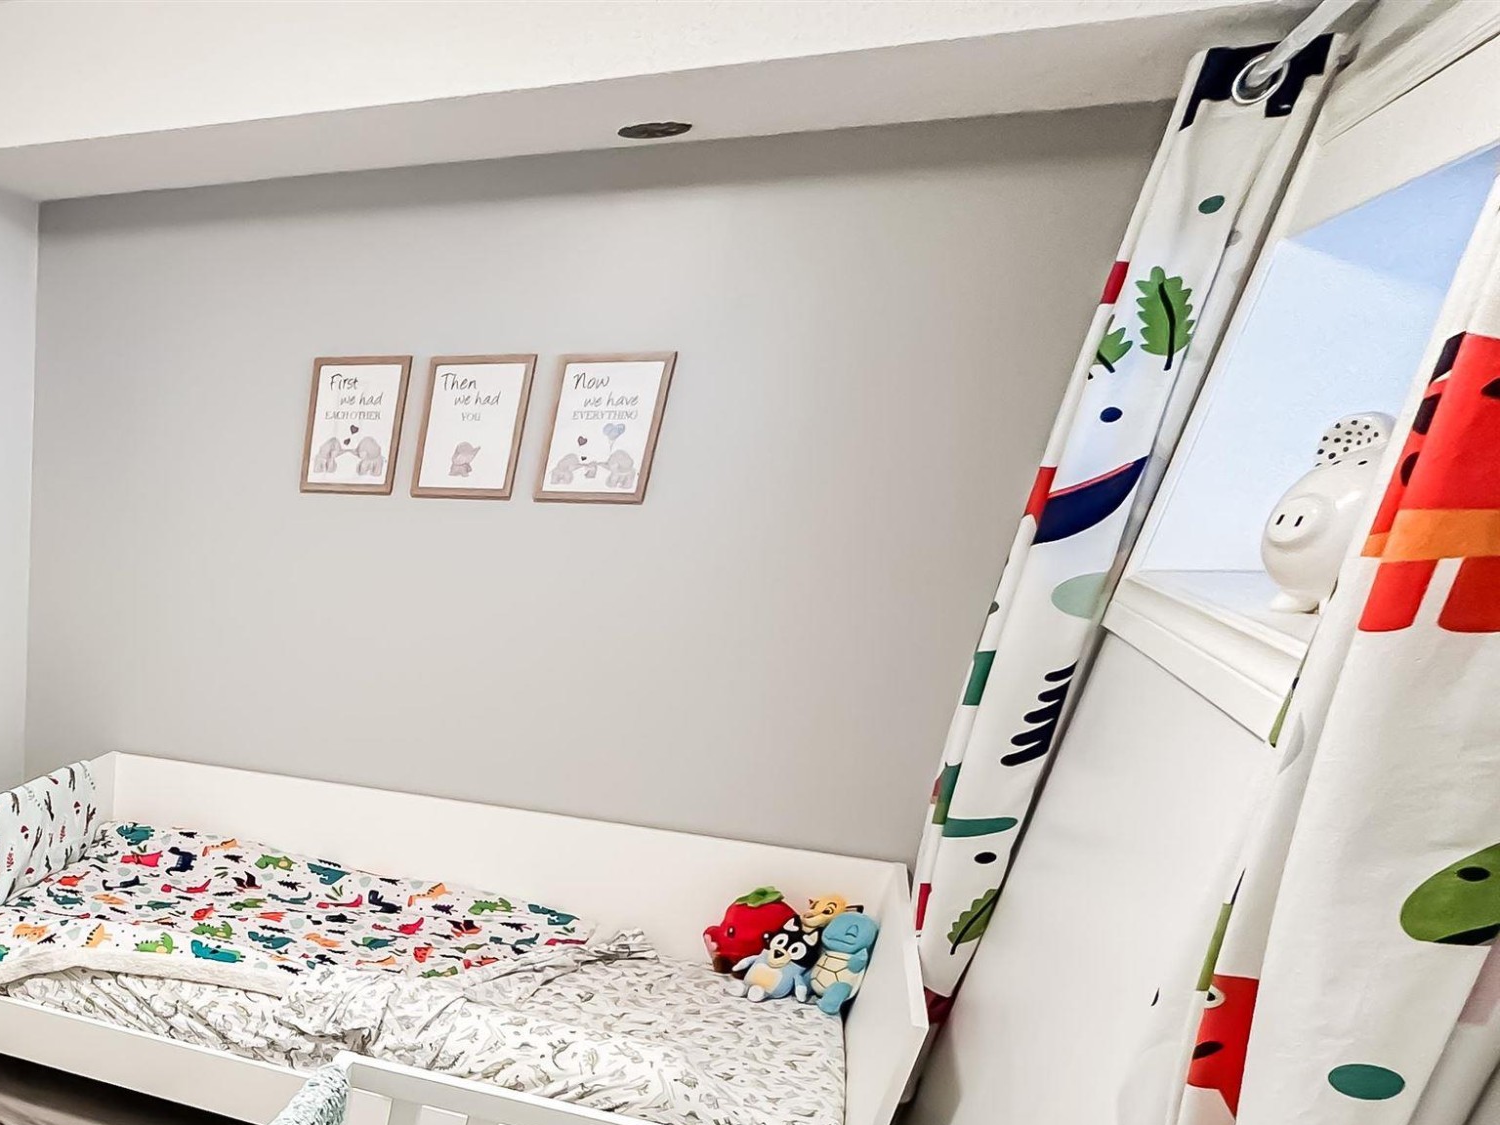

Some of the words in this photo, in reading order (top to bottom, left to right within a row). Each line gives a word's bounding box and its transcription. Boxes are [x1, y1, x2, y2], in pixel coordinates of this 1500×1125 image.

[330, 373, 359, 391] First
[441, 372, 477, 391] Then
[573, 372, 610, 390] Now
[340, 395, 355, 406] we
[359, 392, 384, 406] had
[454, 395, 471, 406] we
[475, 391, 501, 406] had
[584, 396, 602, 407] we
[606, 391, 639, 407] have
[461, 412, 480, 421] YOU
